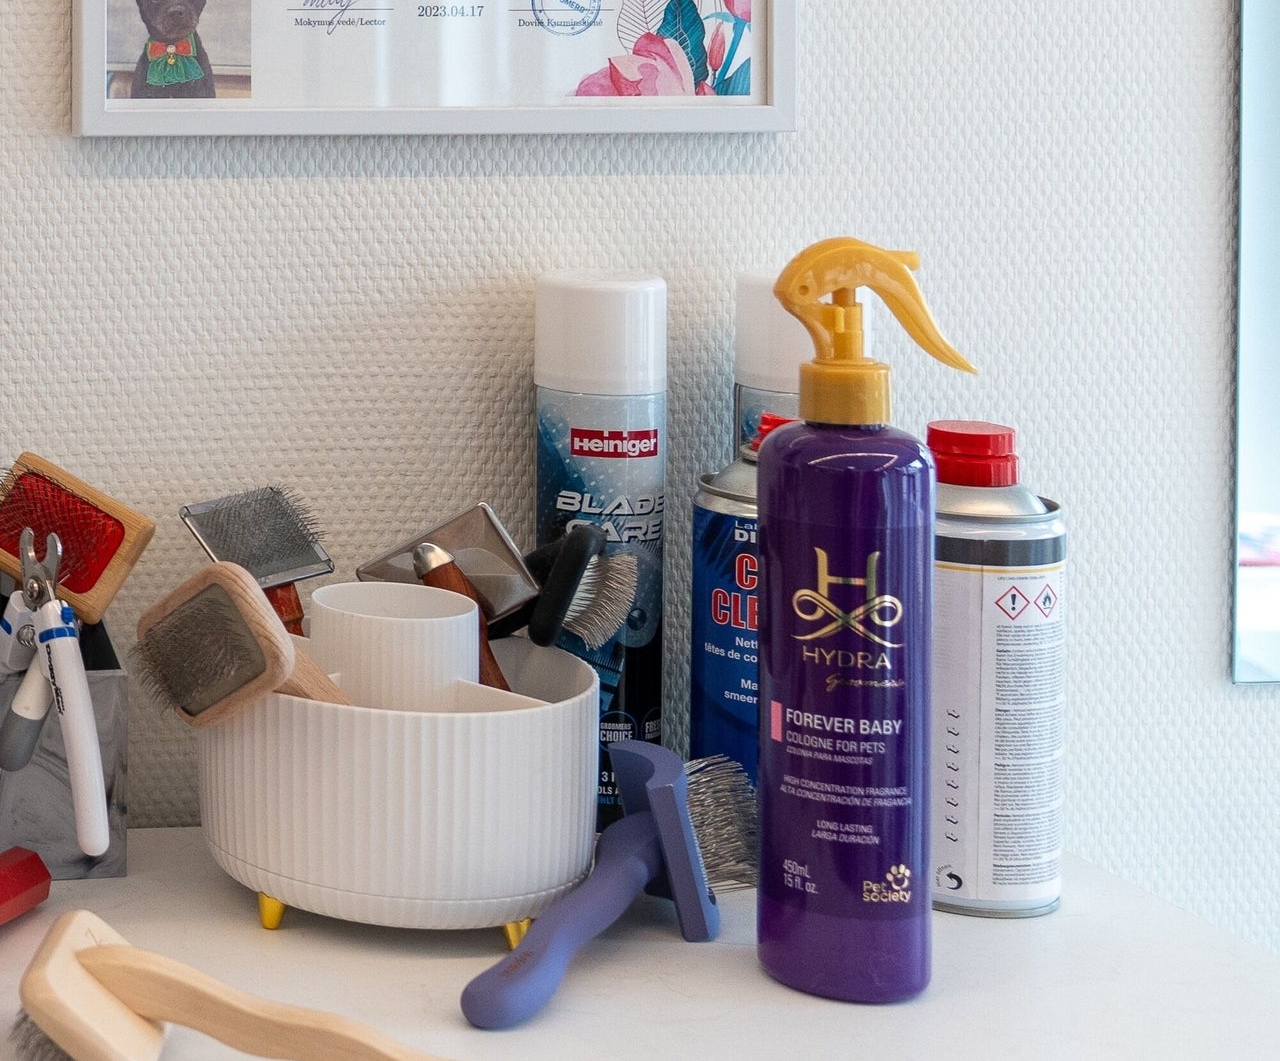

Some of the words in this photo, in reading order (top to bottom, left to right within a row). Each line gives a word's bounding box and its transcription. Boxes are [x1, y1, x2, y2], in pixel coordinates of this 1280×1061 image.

[417, 5, 484, 18] 2023.04.17
[573, 429, 656, 456] Heiniger
[556, 490, 665, 516] BLADE
[705, 641, 725, 656] têtes
[728, 649, 740, 660] de
[803, 645, 892, 669] HYDRA
[786, 708, 854, 733] FOREVER
[860, 719, 901, 735] BABY
[600, 731, 633, 742] CHOICE
[786, 731, 833, 751] COLOGNE
[836, 740, 857, 752] FOR
[860, 741, 885, 754] PETS
[786, 746, 812, 758] COLONIA
[814, 751, 832, 761] PARA
[834, 755, 873, 765] MASCOTAS
[784, 774, 799, 785] HIGH
[800, 778, 864, 796] CONCENTRATION
[865, 786, 907, 796] FRAGRANCE
[780, 784, 795, 795] ALTA
[796, 788, 860, 806] CONCENTRACIÓN
[861, 797, 872, 806] DE
[817, 820, 838, 830] LONG
[840, 822, 873, 833] LASTING
[811, 830, 837, 841] LARGA
[839, 833, 879, 845] DURACIÓN
[782, 859, 810, 878] 450mL
[783, 874, 792, 887] 15
[862, 880, 886, 892] Pet
[862, 890, 911, 902] society
